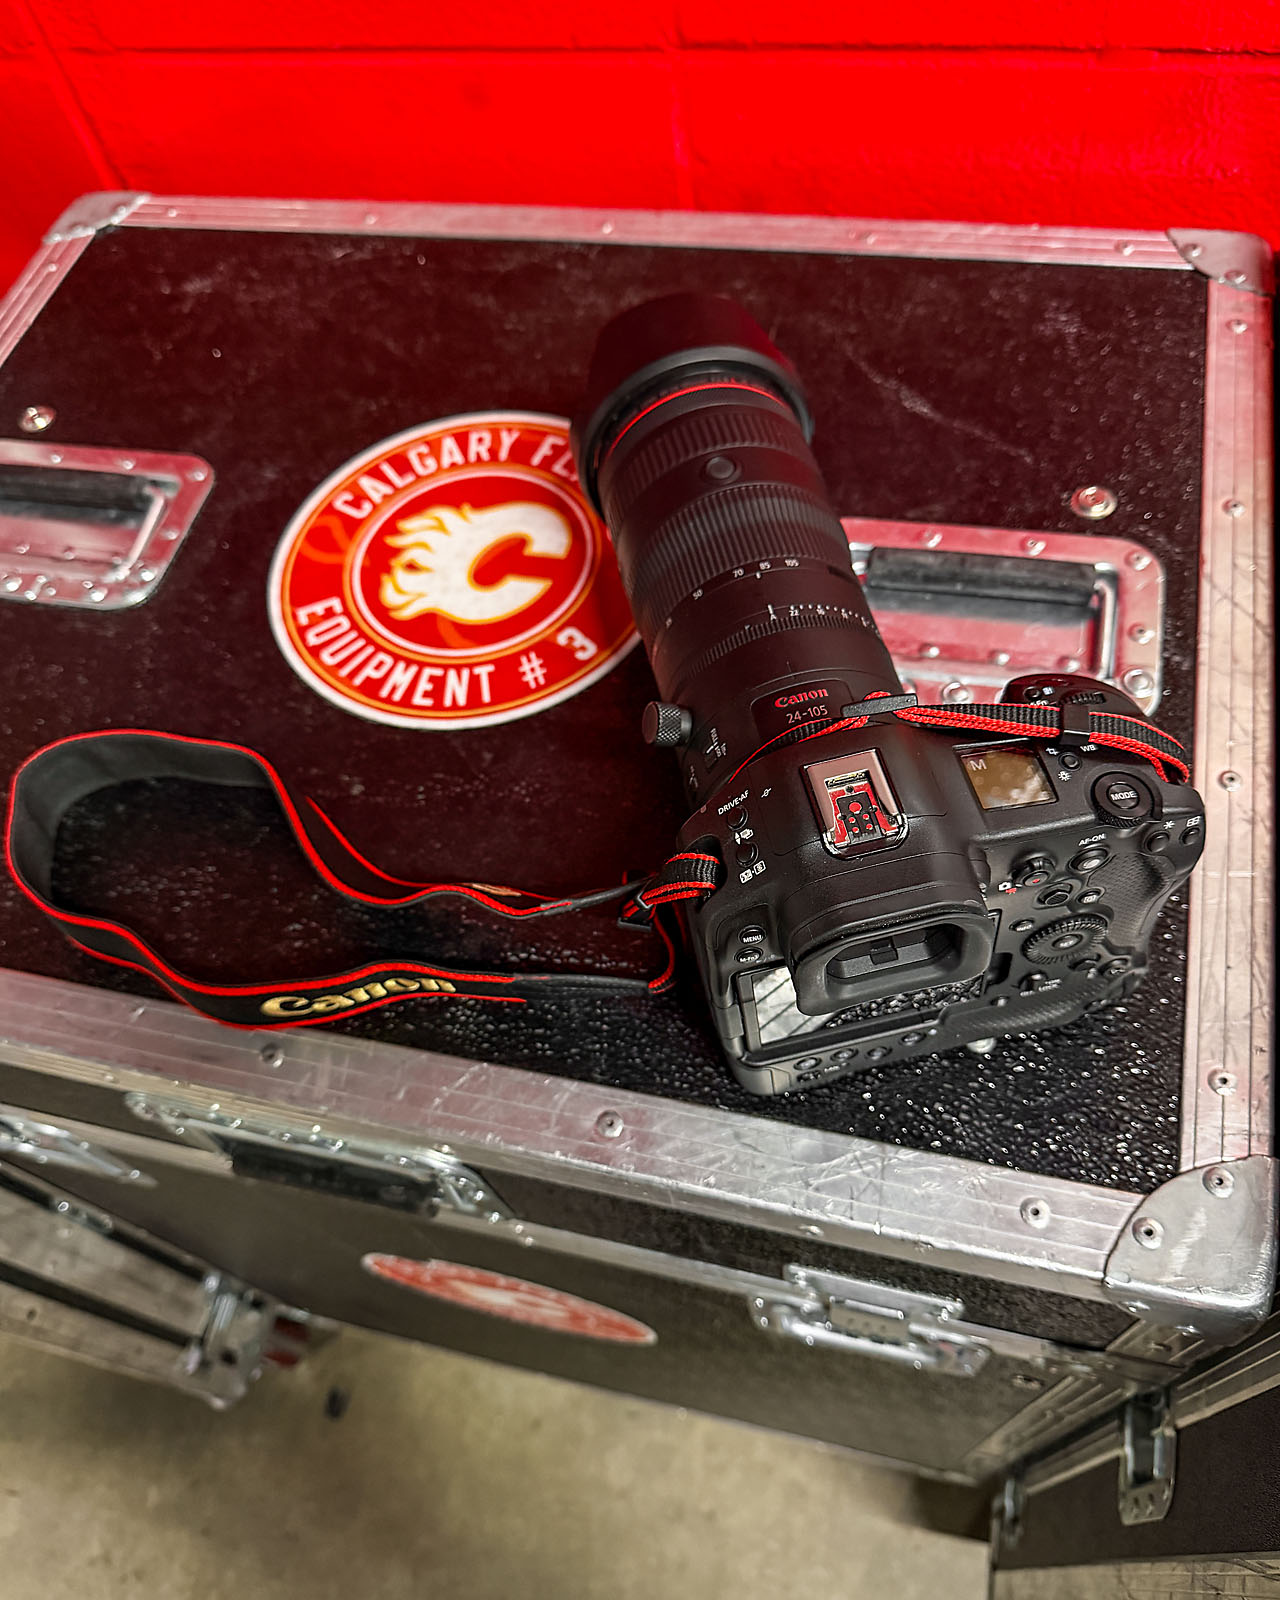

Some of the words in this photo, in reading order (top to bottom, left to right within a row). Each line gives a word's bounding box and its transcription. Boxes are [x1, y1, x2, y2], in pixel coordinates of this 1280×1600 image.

[331, 428, 521, 520] CALGARY
[529, 433, 579, 481] FL
[732, 567, 745, 578] 70
[758, 560, 772, 571] 85
[784, 558, 800, 568] 105
[297, 596, 496, 708] EQUIPMENT
[556, 625, 598, 661] 3
[773, 687, 829, 708] Canon
[785, 704, 829, 725] 24-105
[1079, 743, 1098, 752] WB
[968, 758, 988, 771] M
[1110, 790, 1138, 802] MODE
[1078, 833, 1106, 847] AF-ON
[742, 934, 764, 944] MENU
[260, 977, 457, 1017] Canon
